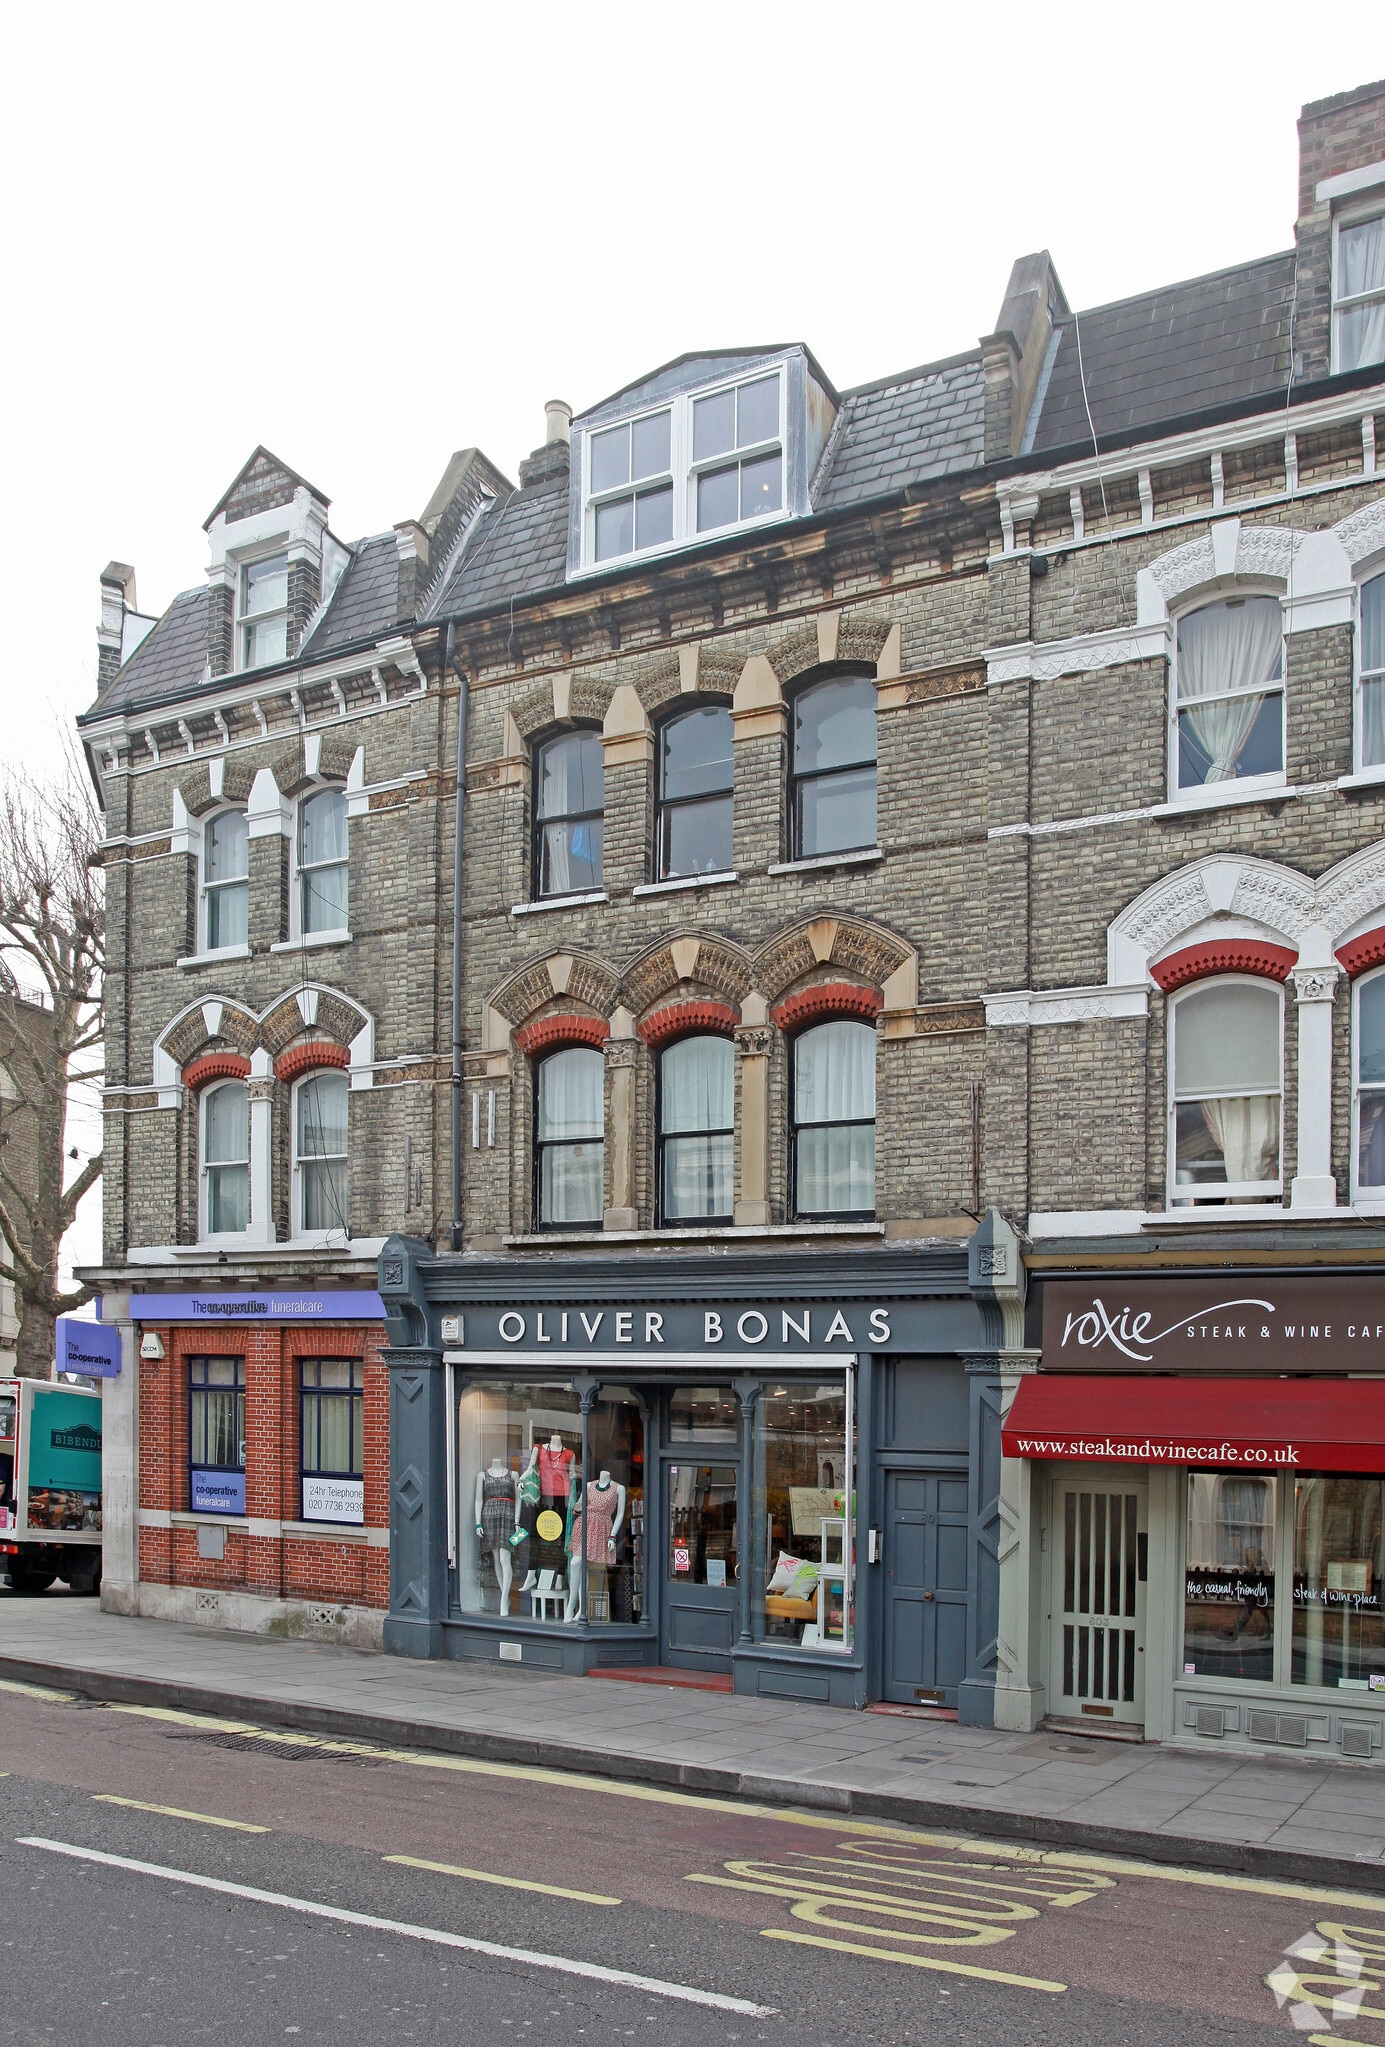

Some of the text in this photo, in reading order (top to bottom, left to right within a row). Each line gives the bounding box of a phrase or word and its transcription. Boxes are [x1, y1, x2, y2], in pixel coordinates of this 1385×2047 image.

[191, 1300, 206, 1314] The
[271, 1300, 324, 1314] funeralcare
[498, 1308, 891, 1344] OLIVER BONAS
[1187, 1325, 1247, 1338] STEAK
[1260, 1325, 1271, 1338] &
[1284, 1325, 1332, 1338] WINE
[67, 1341, 79, 1351] The
[68, 1352, 111, 1365] co-operative
[67, 1361, 104, 1373] funeralcare
[1017, 1439, 1299, 1463] www.steakandwinecafe.co.uk
[196, 1474, 206, 1484] The
[196, 1486, 238, 1496] co-operative
[310, 1486, 363, 1499] 24hr Telephone
[196, 1496, 231, 1507] funeralcare
[309, 1499, 364, 1513] 020 7736 2939
[1187, 1580, 1203, 1595] the
[1235, 1581, 1268, 1607] friendly
[1293, 1584, 1318, 1600] steak
